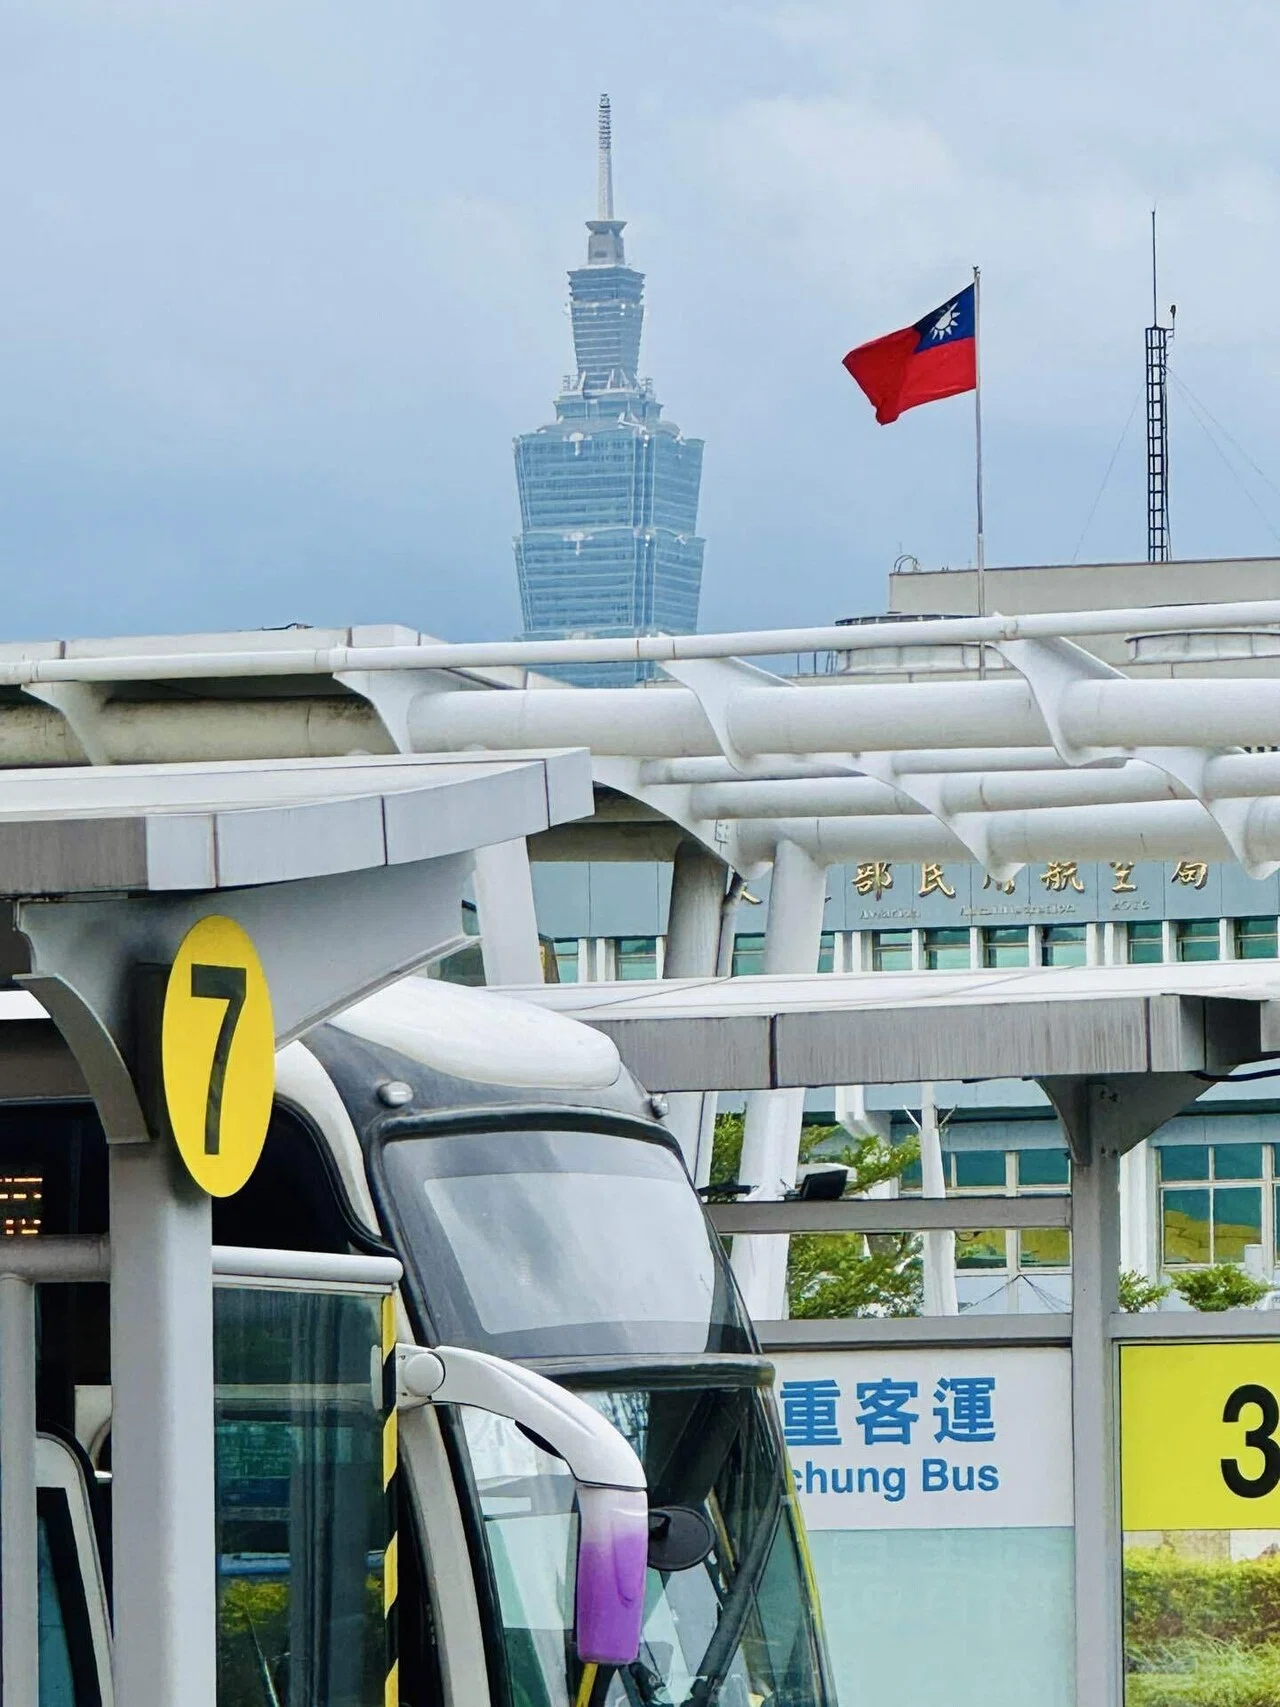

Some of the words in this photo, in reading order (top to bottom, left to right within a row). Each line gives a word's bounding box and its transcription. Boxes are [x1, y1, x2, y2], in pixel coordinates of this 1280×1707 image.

[191, 963, 247, 1155] 7
[780, 1377, 996, 1446] 重客運
[1220, 1384, 1280, 1498] 3
[922, 1458, 1000, 1492] Bus
